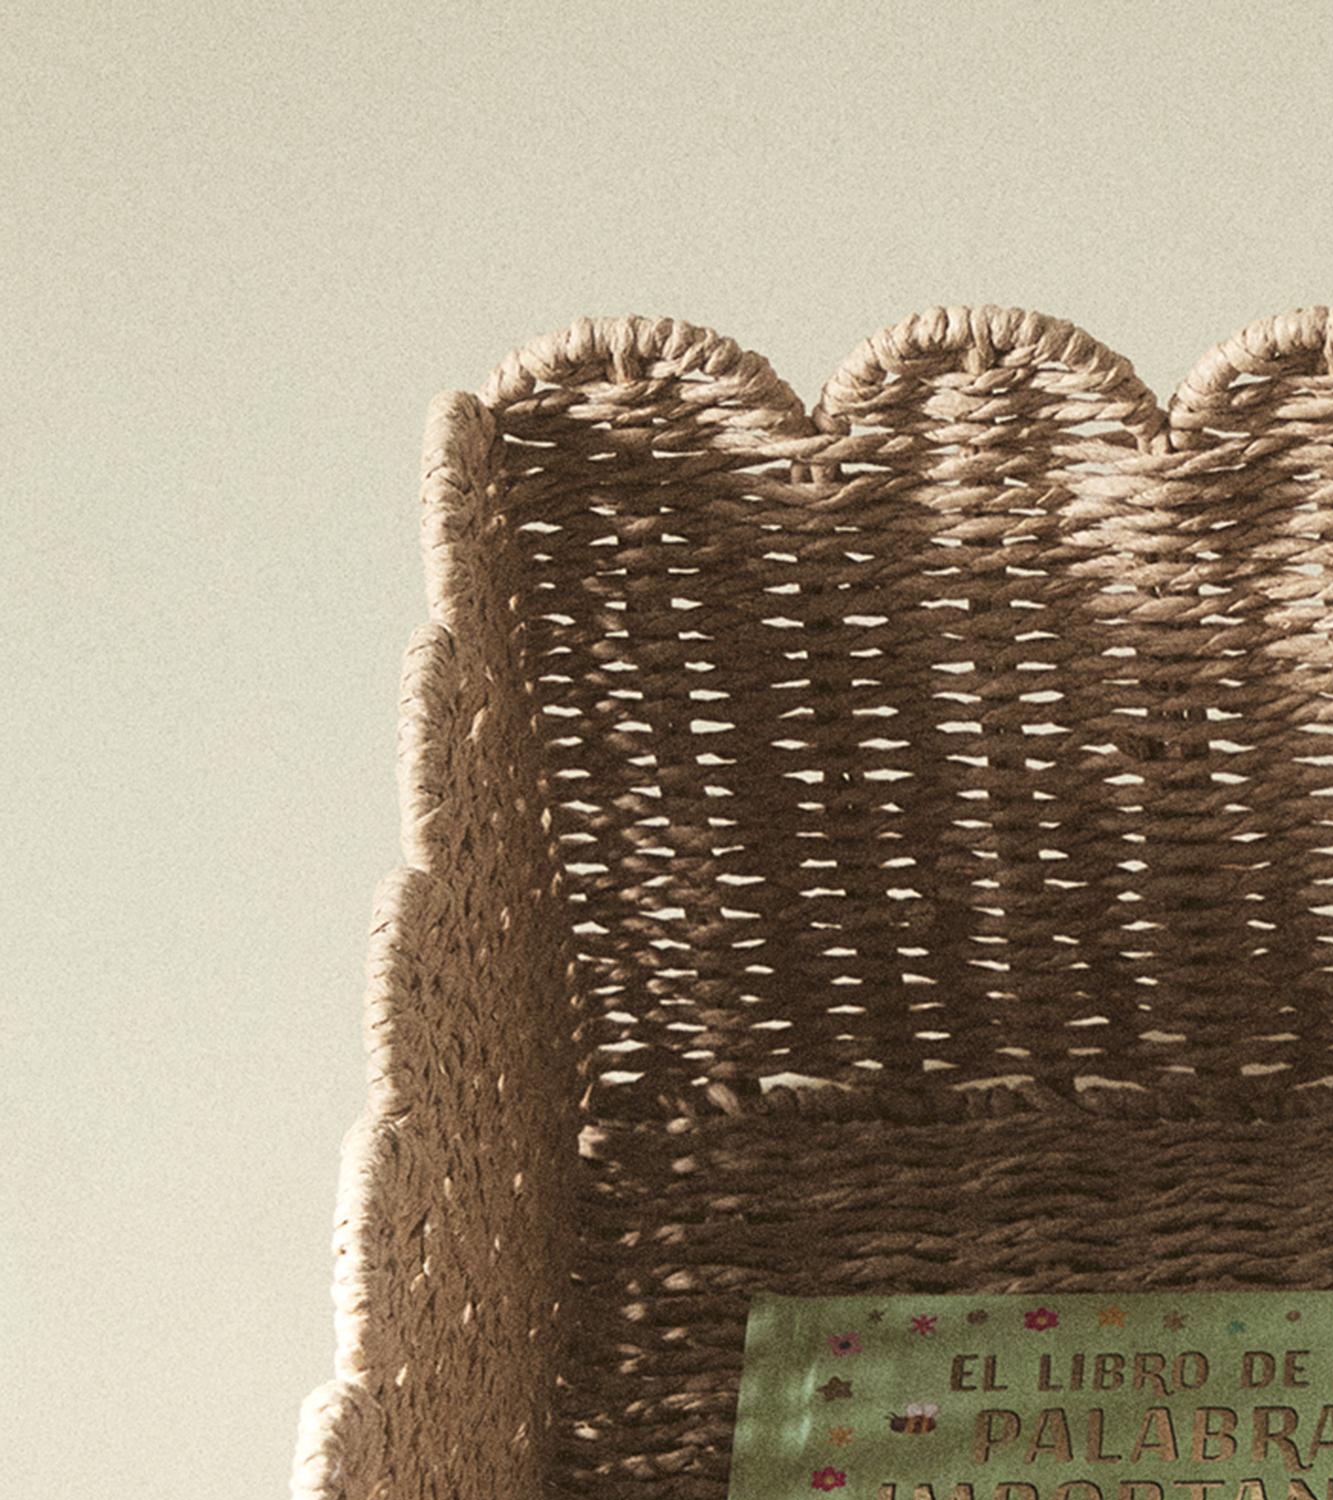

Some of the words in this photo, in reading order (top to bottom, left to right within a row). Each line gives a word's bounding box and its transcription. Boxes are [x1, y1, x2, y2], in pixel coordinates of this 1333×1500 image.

[950, 1354, 1008, 1392] EL
[1037, 1351, 1209, 1397] LIBRO
[1240, 1350, 1311, 1389] DE
